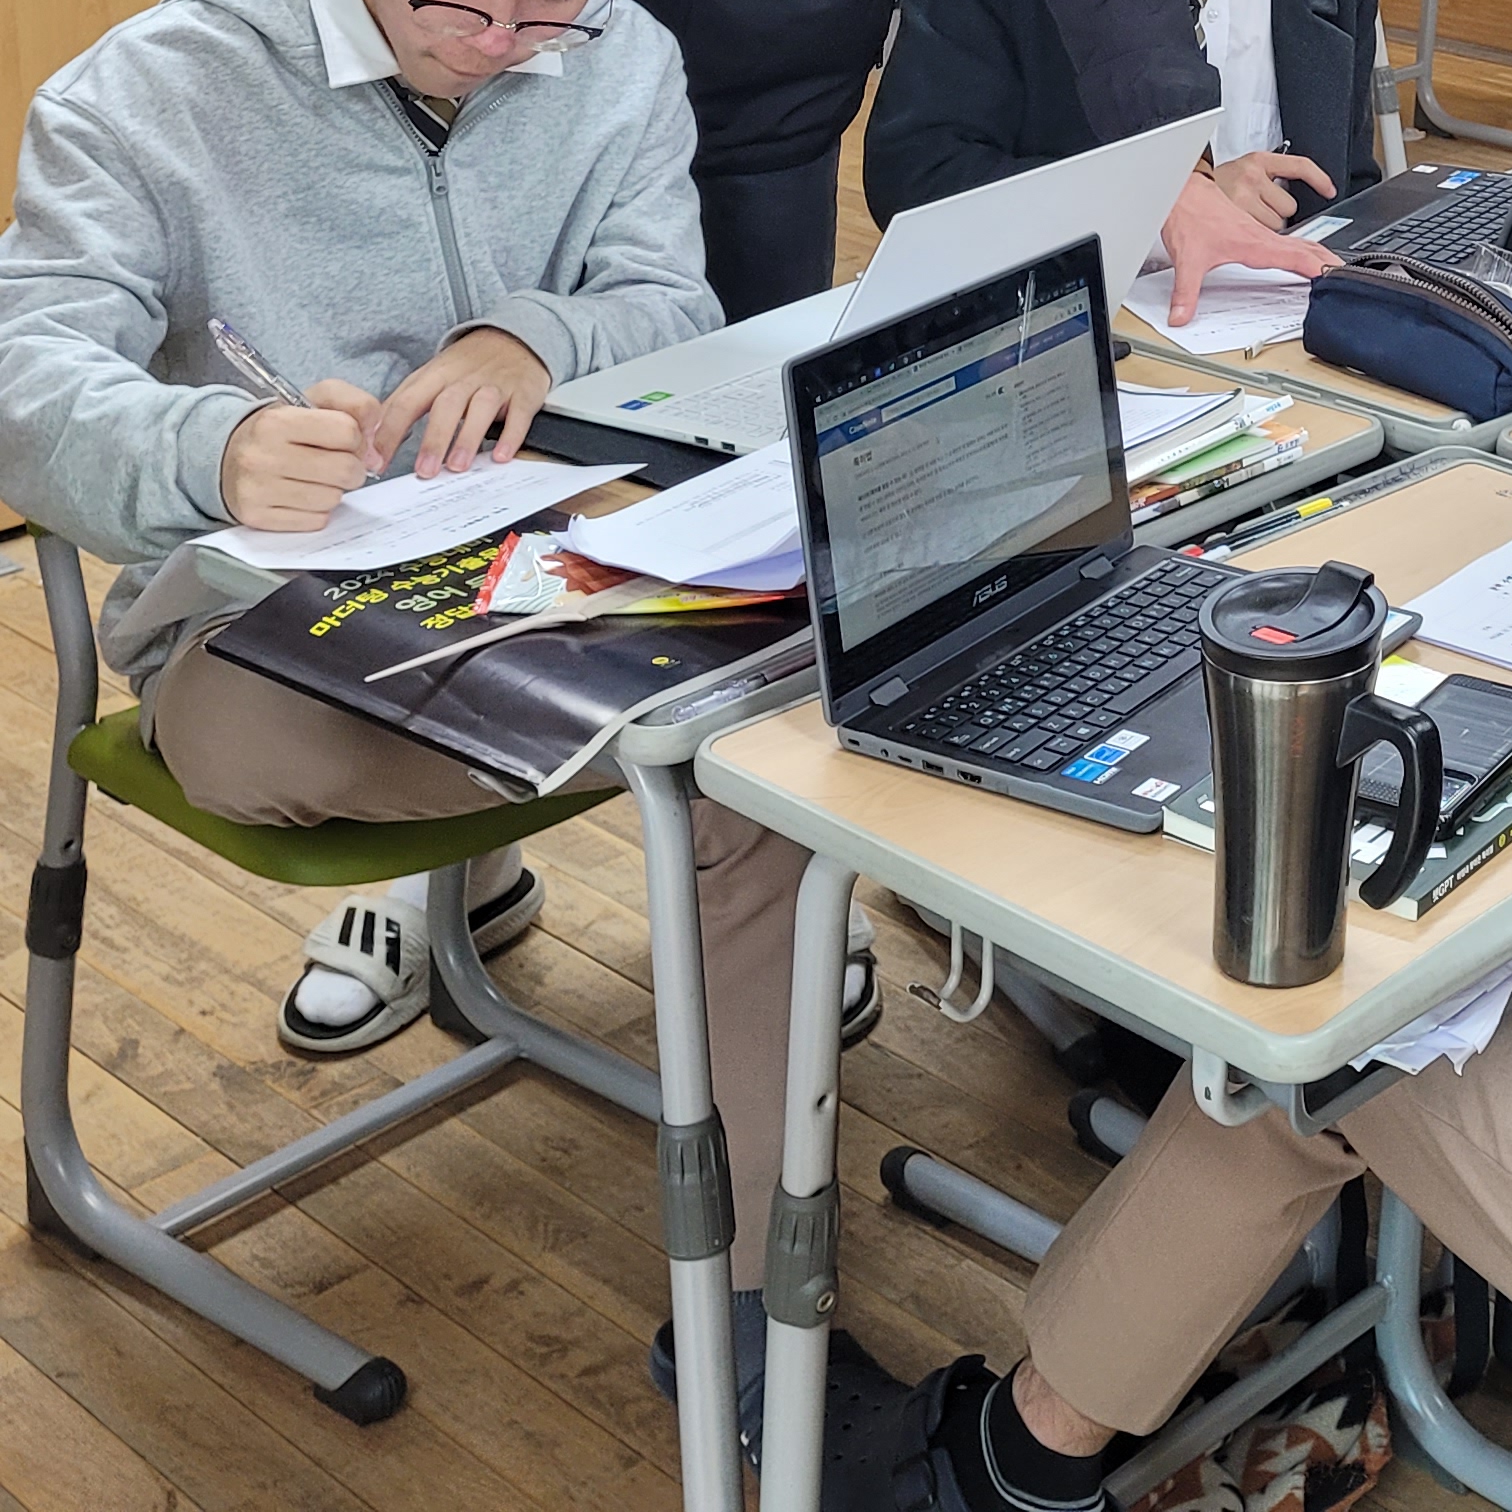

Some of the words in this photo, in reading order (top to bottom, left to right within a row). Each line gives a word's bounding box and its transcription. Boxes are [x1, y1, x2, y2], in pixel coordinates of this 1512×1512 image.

[323, 570, 395, 601] 2024
[395, 585, 468, 612] 영어
[972, 574, 1008, 608] ASUS
[309, 588, 389, 637] 마더텅
